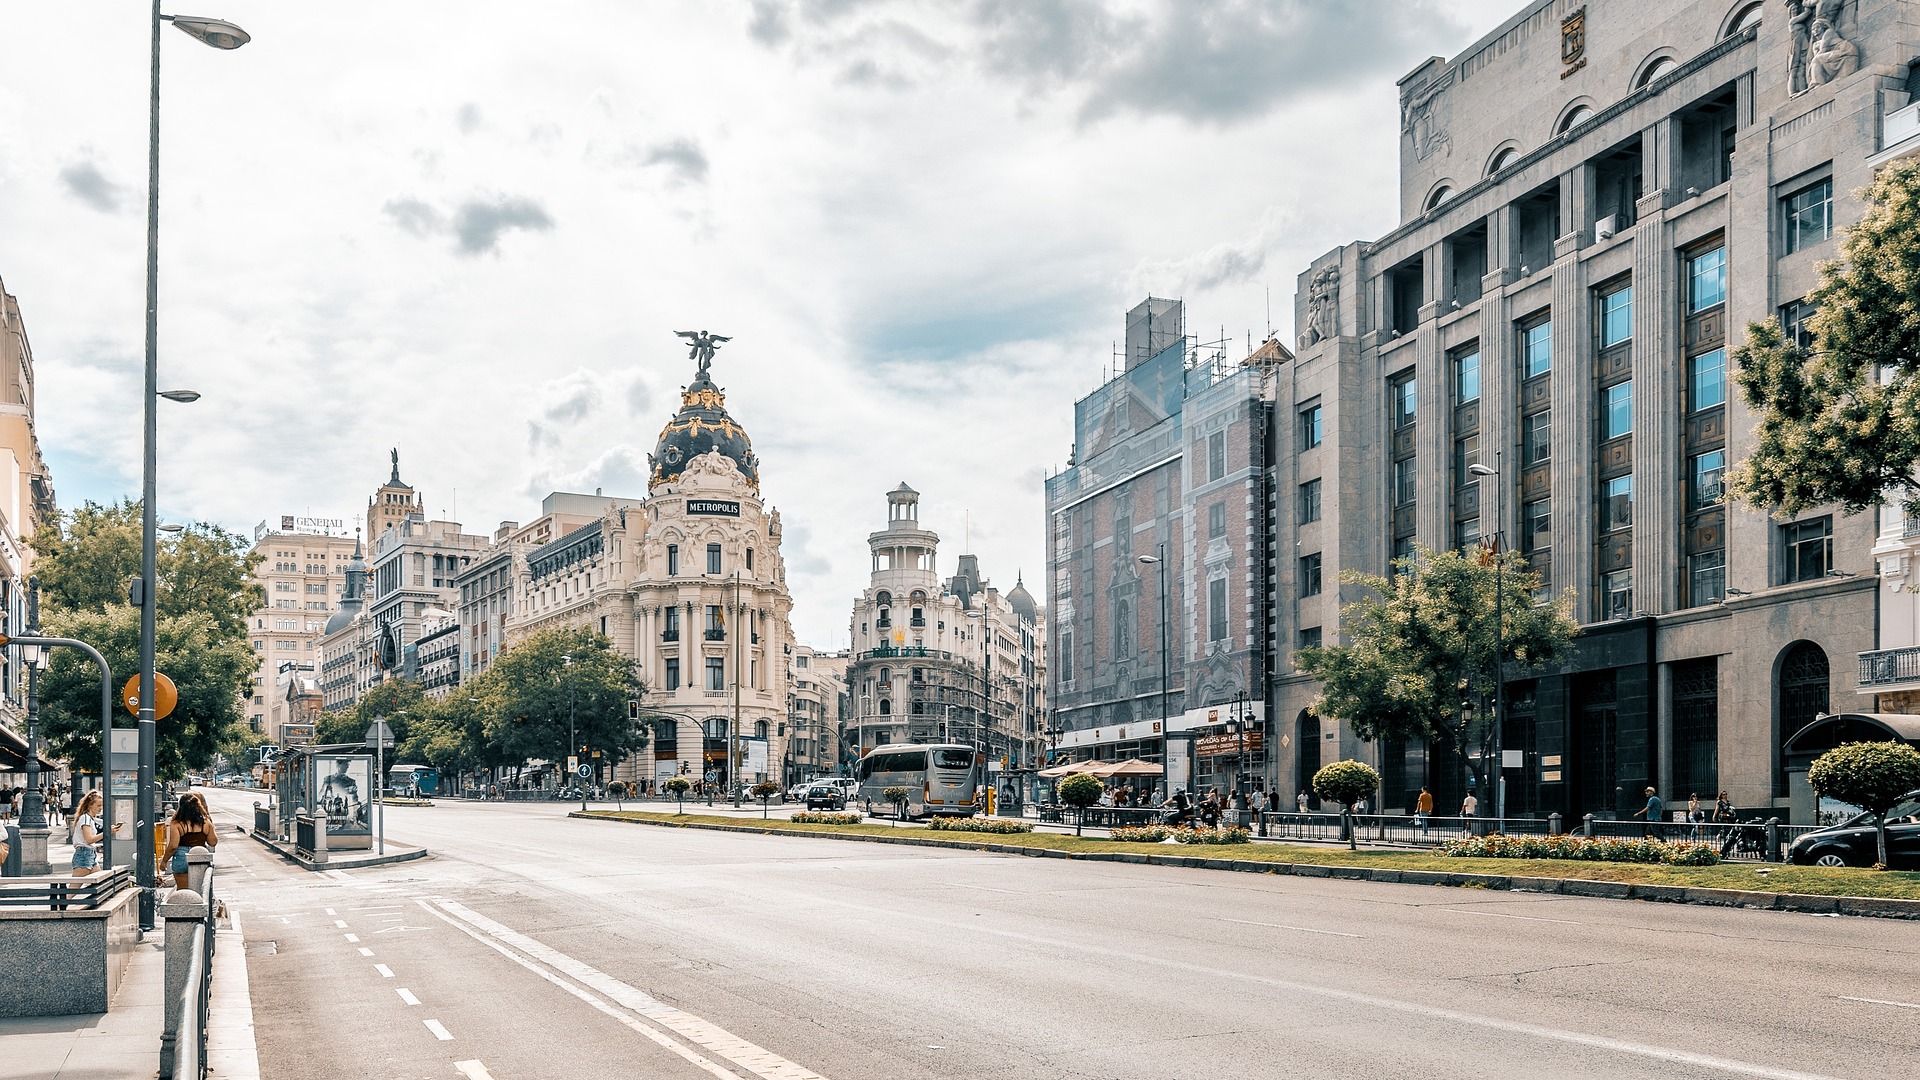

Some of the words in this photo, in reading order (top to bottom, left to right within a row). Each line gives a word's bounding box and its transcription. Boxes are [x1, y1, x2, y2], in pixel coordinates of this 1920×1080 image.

[1560, 57, 1587, 80] madrid
[690, 502, 738, 513] METROPOLIS
[297, 517, 343, 528] GENERALI
[872, 645, 928, 657] ROLEX
